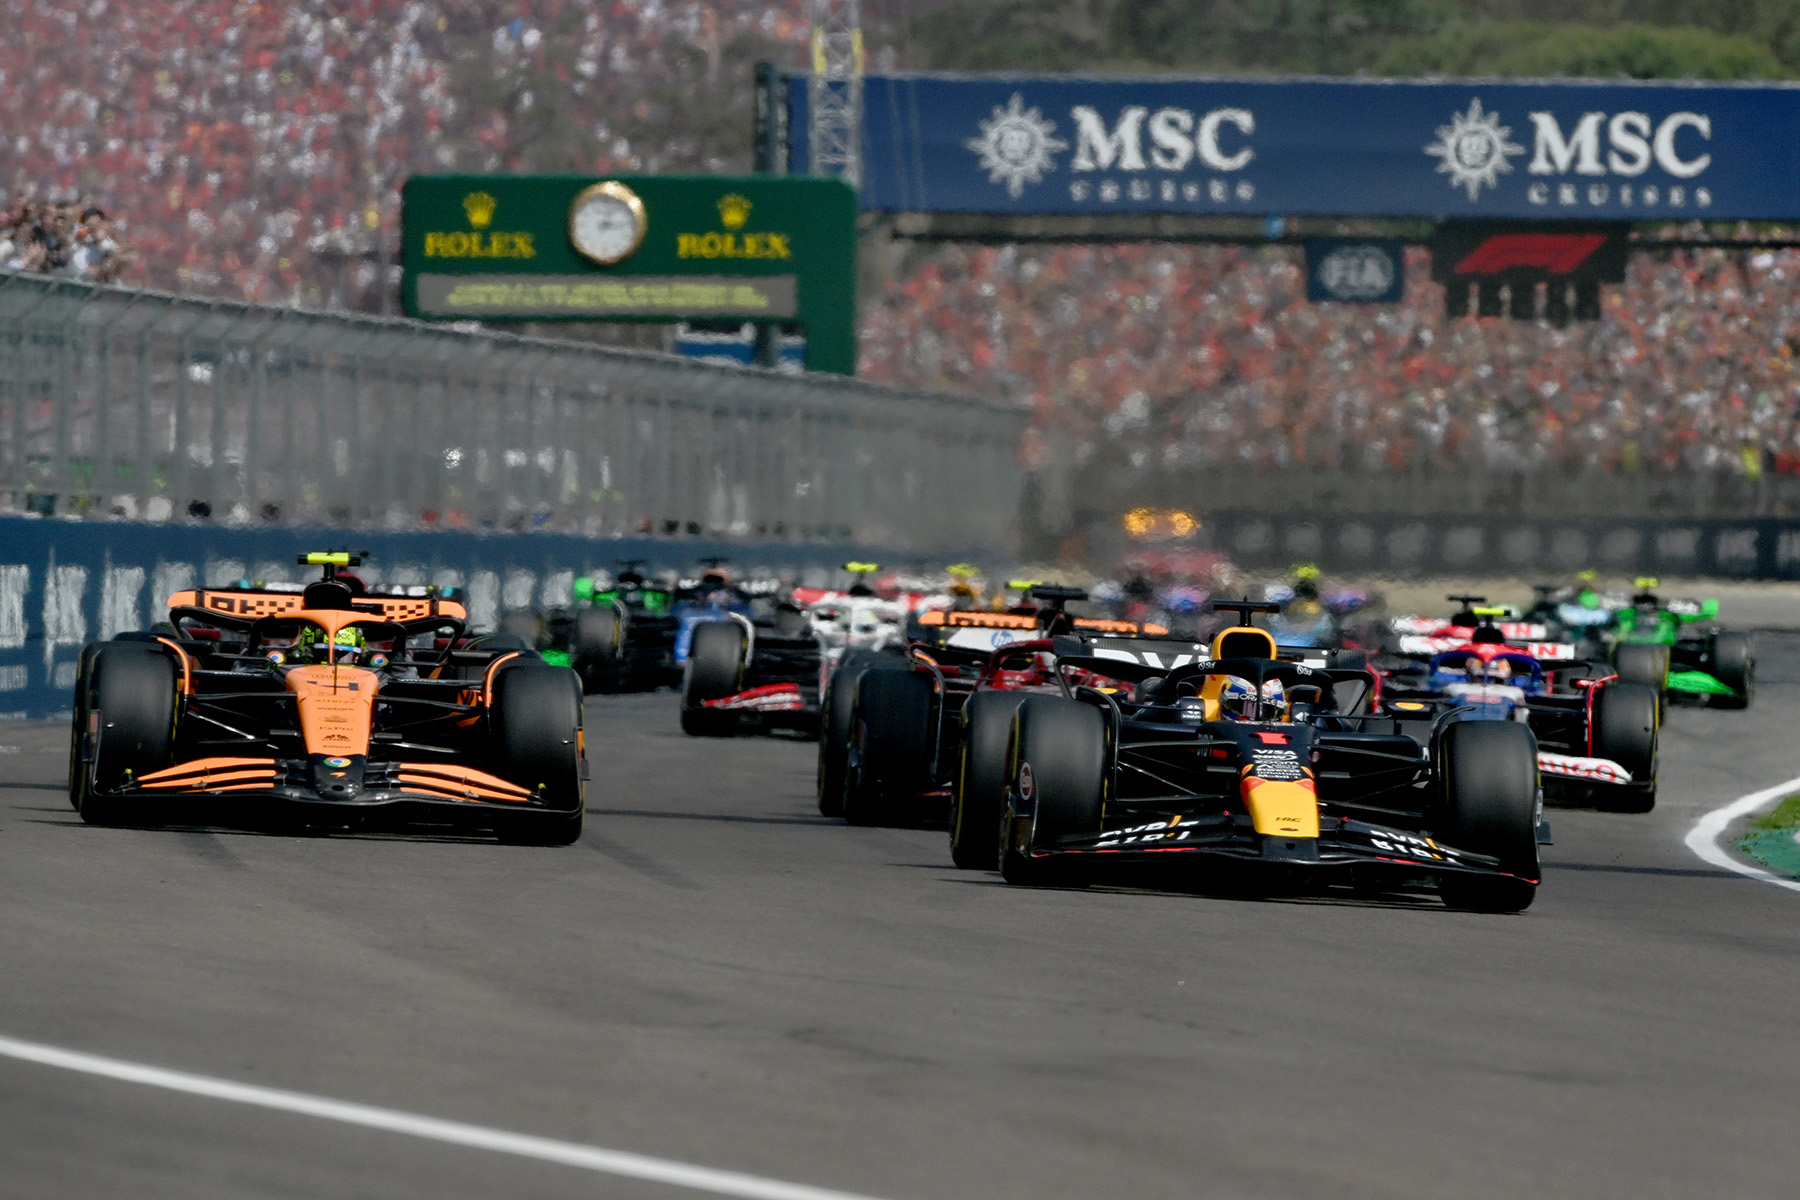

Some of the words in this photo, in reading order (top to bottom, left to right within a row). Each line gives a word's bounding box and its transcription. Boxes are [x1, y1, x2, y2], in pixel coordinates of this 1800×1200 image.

[1070, 105, 1256, 172] MSC
[1527, 111, 1712, 178] MSC
[1527, 183, 1713, 207] CRUISES
[424, 232, 536, 258] ROLEX
[676, 233, 792, 258] ROLEX
[1330, 256, 1389, 286] FIA
